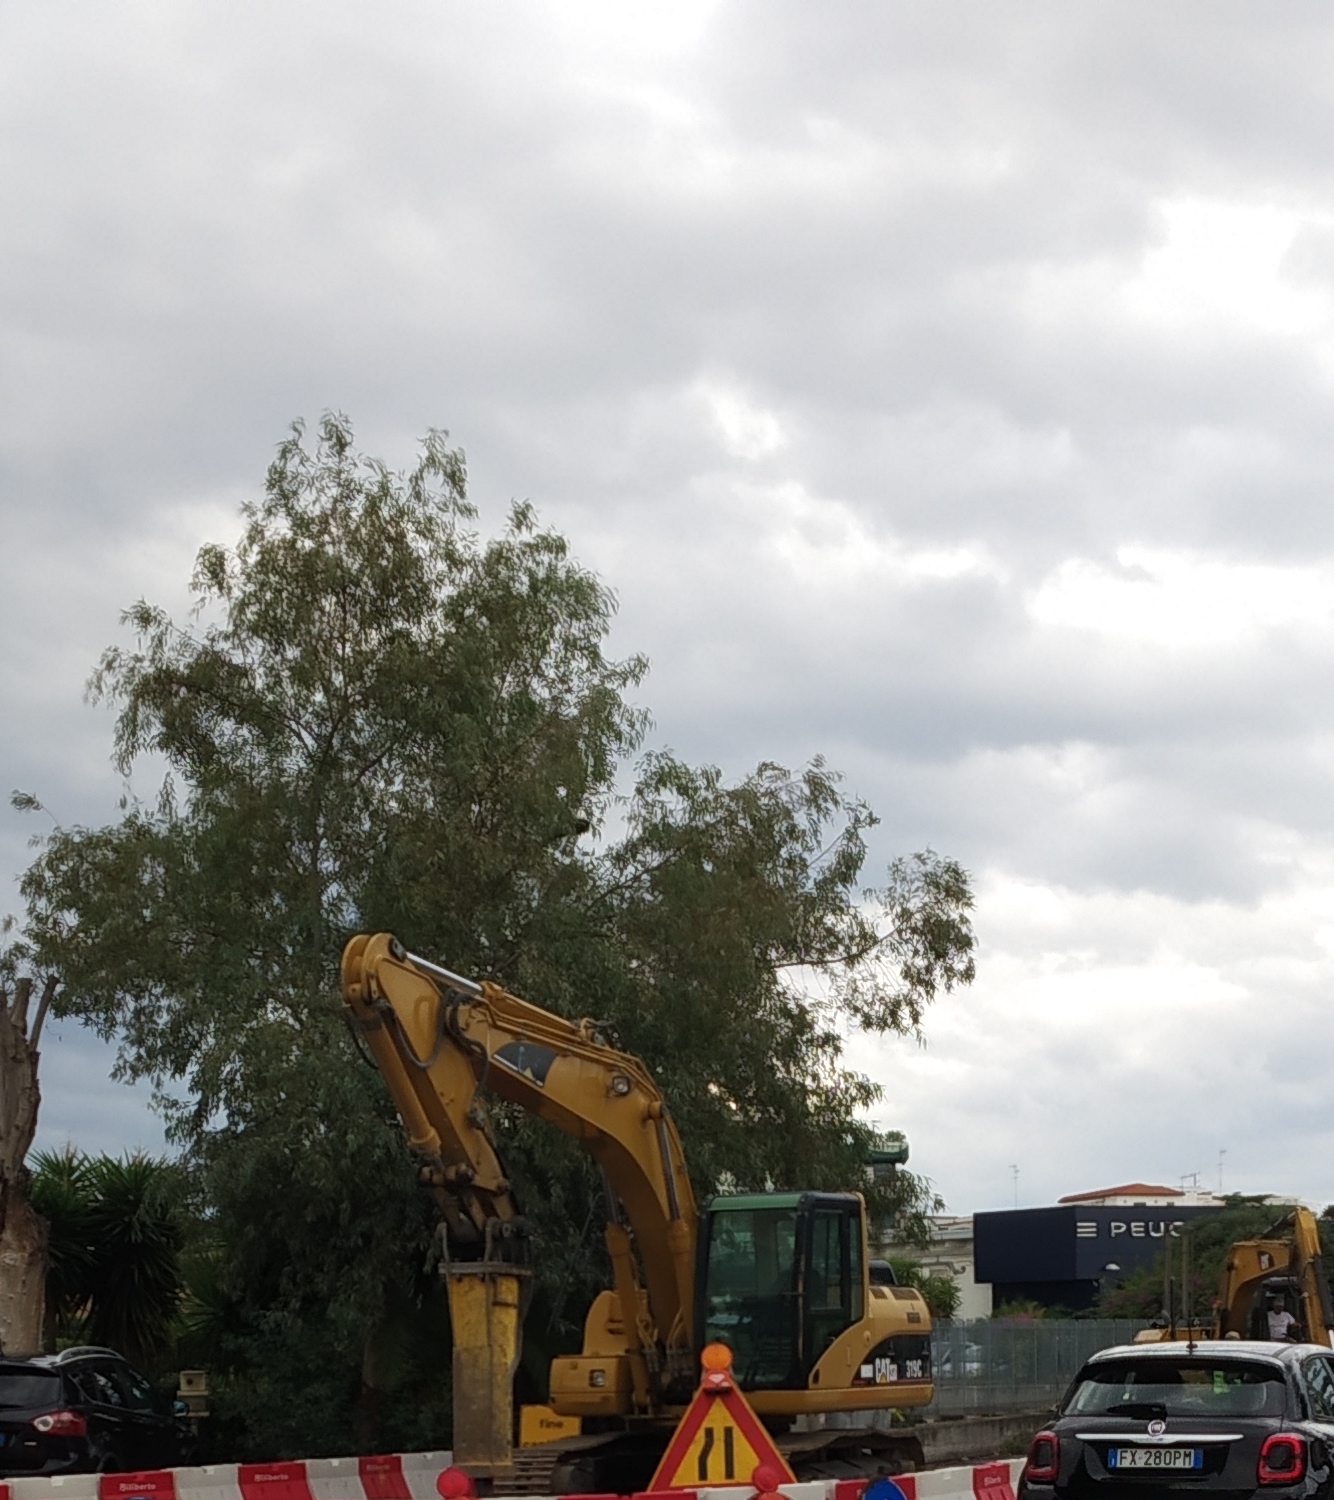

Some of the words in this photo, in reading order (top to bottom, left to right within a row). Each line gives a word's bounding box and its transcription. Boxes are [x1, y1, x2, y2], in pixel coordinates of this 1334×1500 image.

[875, 1357, 891, 1384] CAT
[1119, 1450, 1137, 1466] FX
[1143, 1450, 1192, 1467] 280PM
